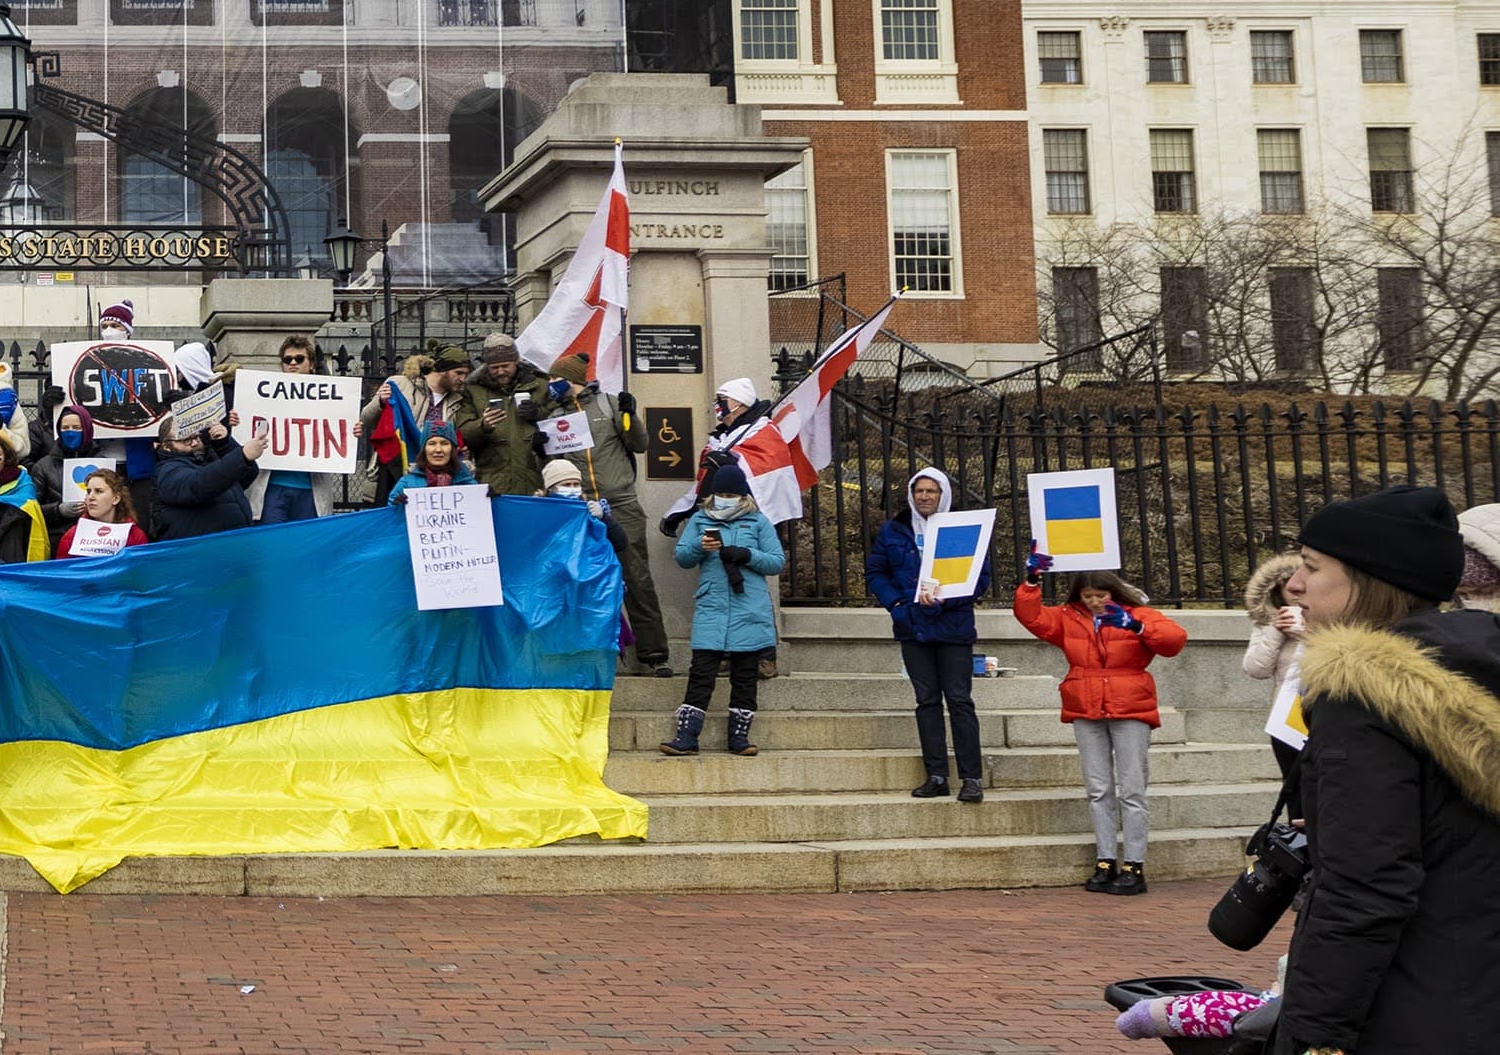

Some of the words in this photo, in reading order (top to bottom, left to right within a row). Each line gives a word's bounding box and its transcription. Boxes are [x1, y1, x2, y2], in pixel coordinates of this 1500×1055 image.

[629, 181, 720, 195] ULFINCH
[629, 224, 724, 239] NTRANCE
[24, 237, 113, 258] STATE
[124, 237, 230, 258] HOUSE
[257, 380, 343, 400] CANCEL
[415, 492, 465, 511] HELP
[80, 538, 120, 547] RUSSIAN
[420, 530, 455, 545] BEAT
